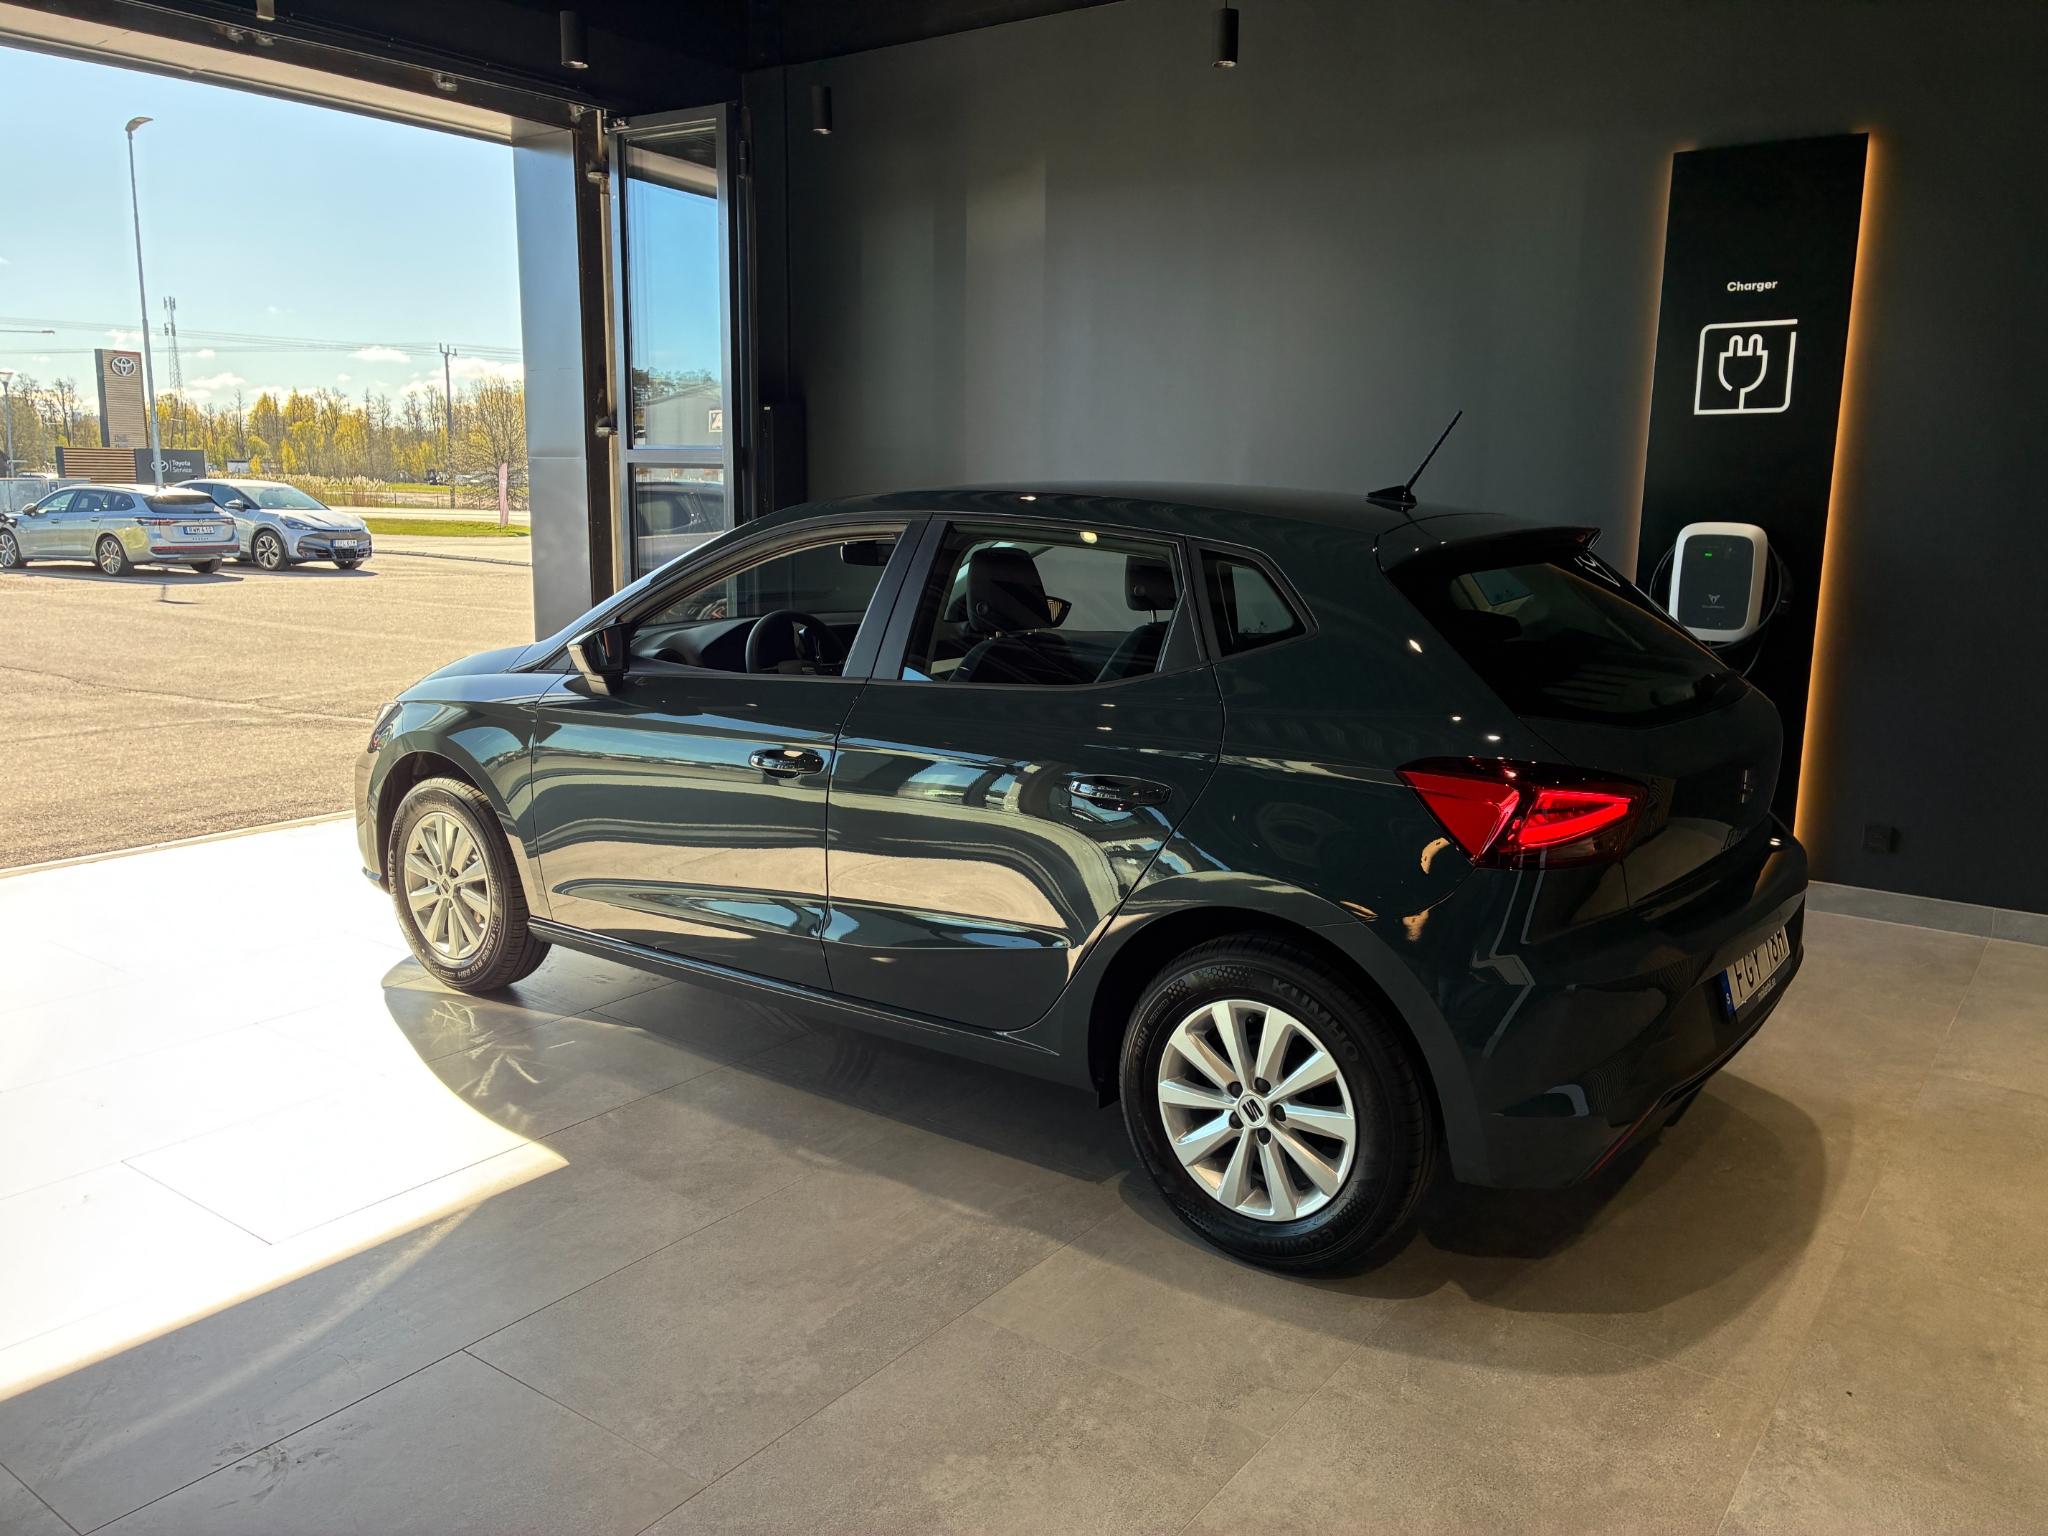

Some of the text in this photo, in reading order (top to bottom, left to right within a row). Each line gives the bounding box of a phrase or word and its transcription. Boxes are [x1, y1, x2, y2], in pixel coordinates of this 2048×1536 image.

[1727, 281, 1778, 292] Charger
[1725, 993, 1731, 1005] S
[1271, 978, 1360, 1062] KUMHO
[1134, 1026, 1150, 1058] 88H
